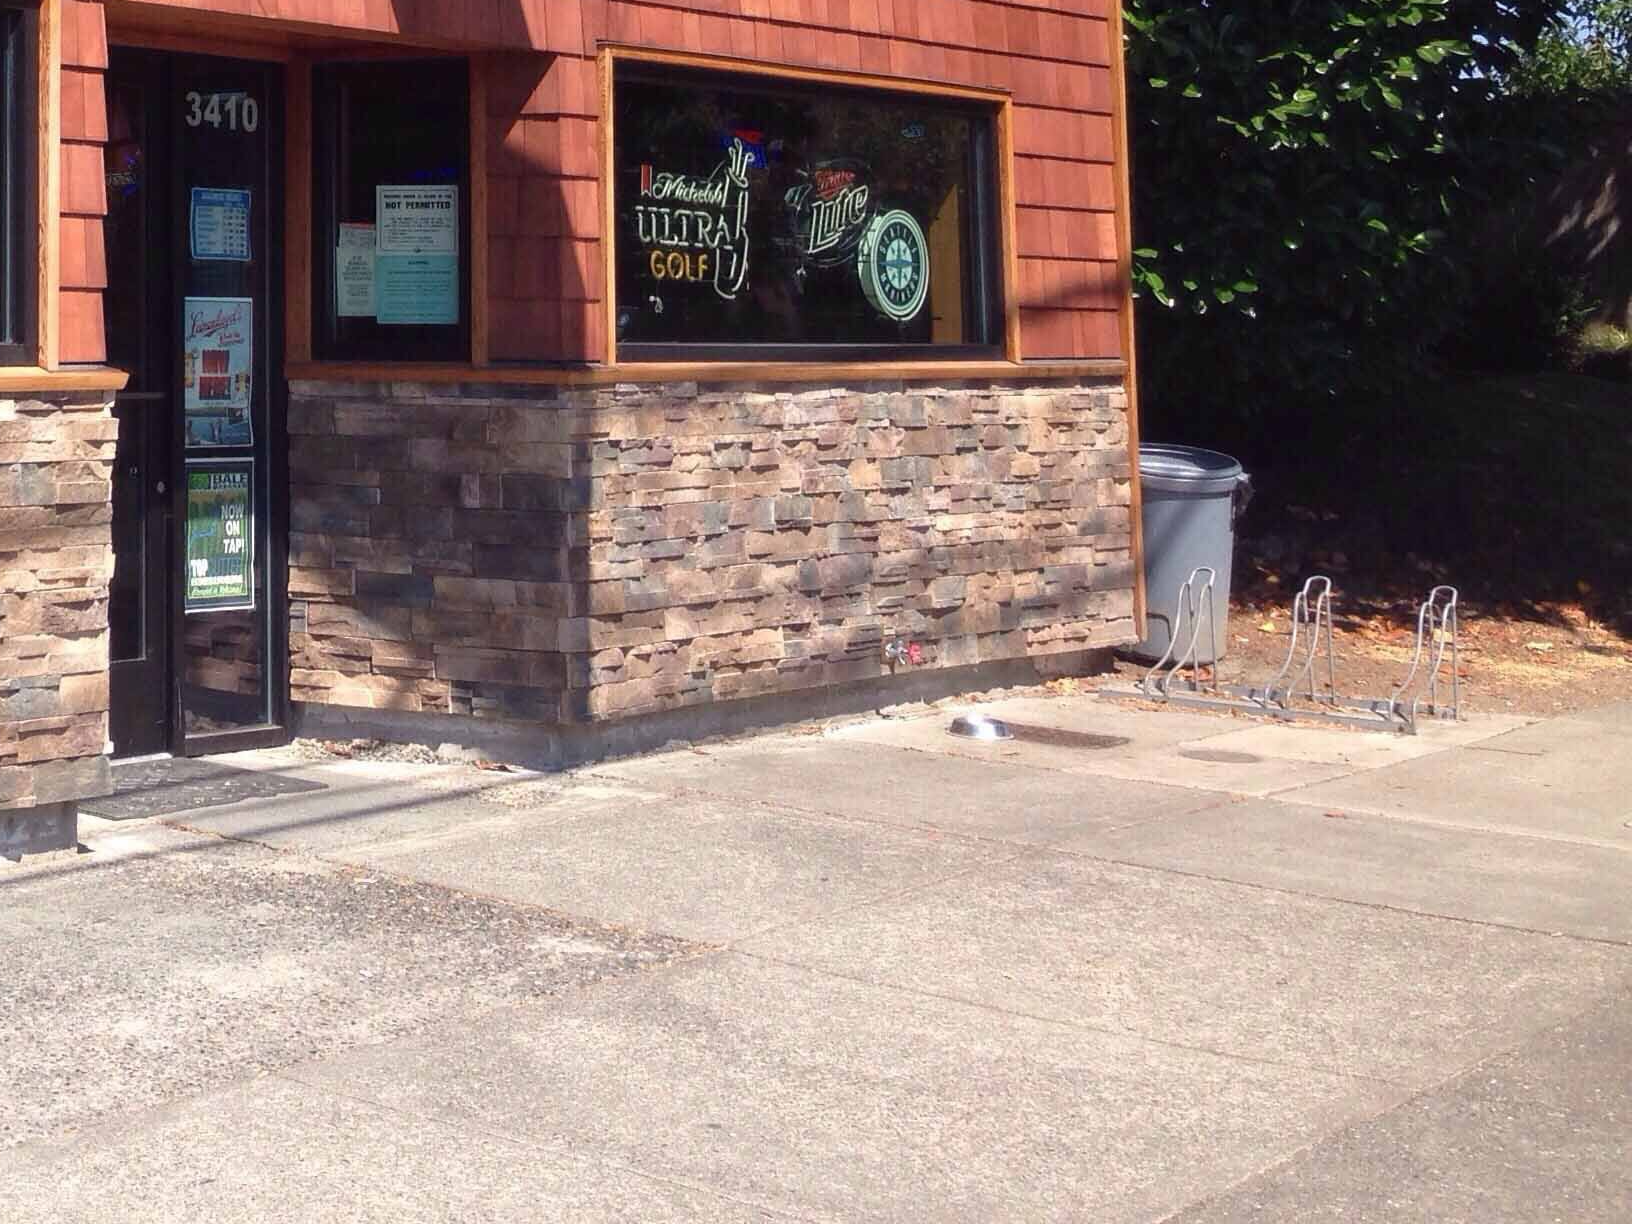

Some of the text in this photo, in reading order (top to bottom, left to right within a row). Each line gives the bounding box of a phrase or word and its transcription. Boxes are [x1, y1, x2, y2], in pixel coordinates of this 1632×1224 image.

[185, 90, 259, 132] 3410
[652, 172, 723, 204] Michelob
[385, 201, 401, 209] NOT
[634, 205, 734, 251] ULTRA
[650, 250, 709, 282] GOLF
[221, 504, 245, 520] NOW
[225, 520, 240, 535] ON
[223, 538, 245, 554] TAP!
